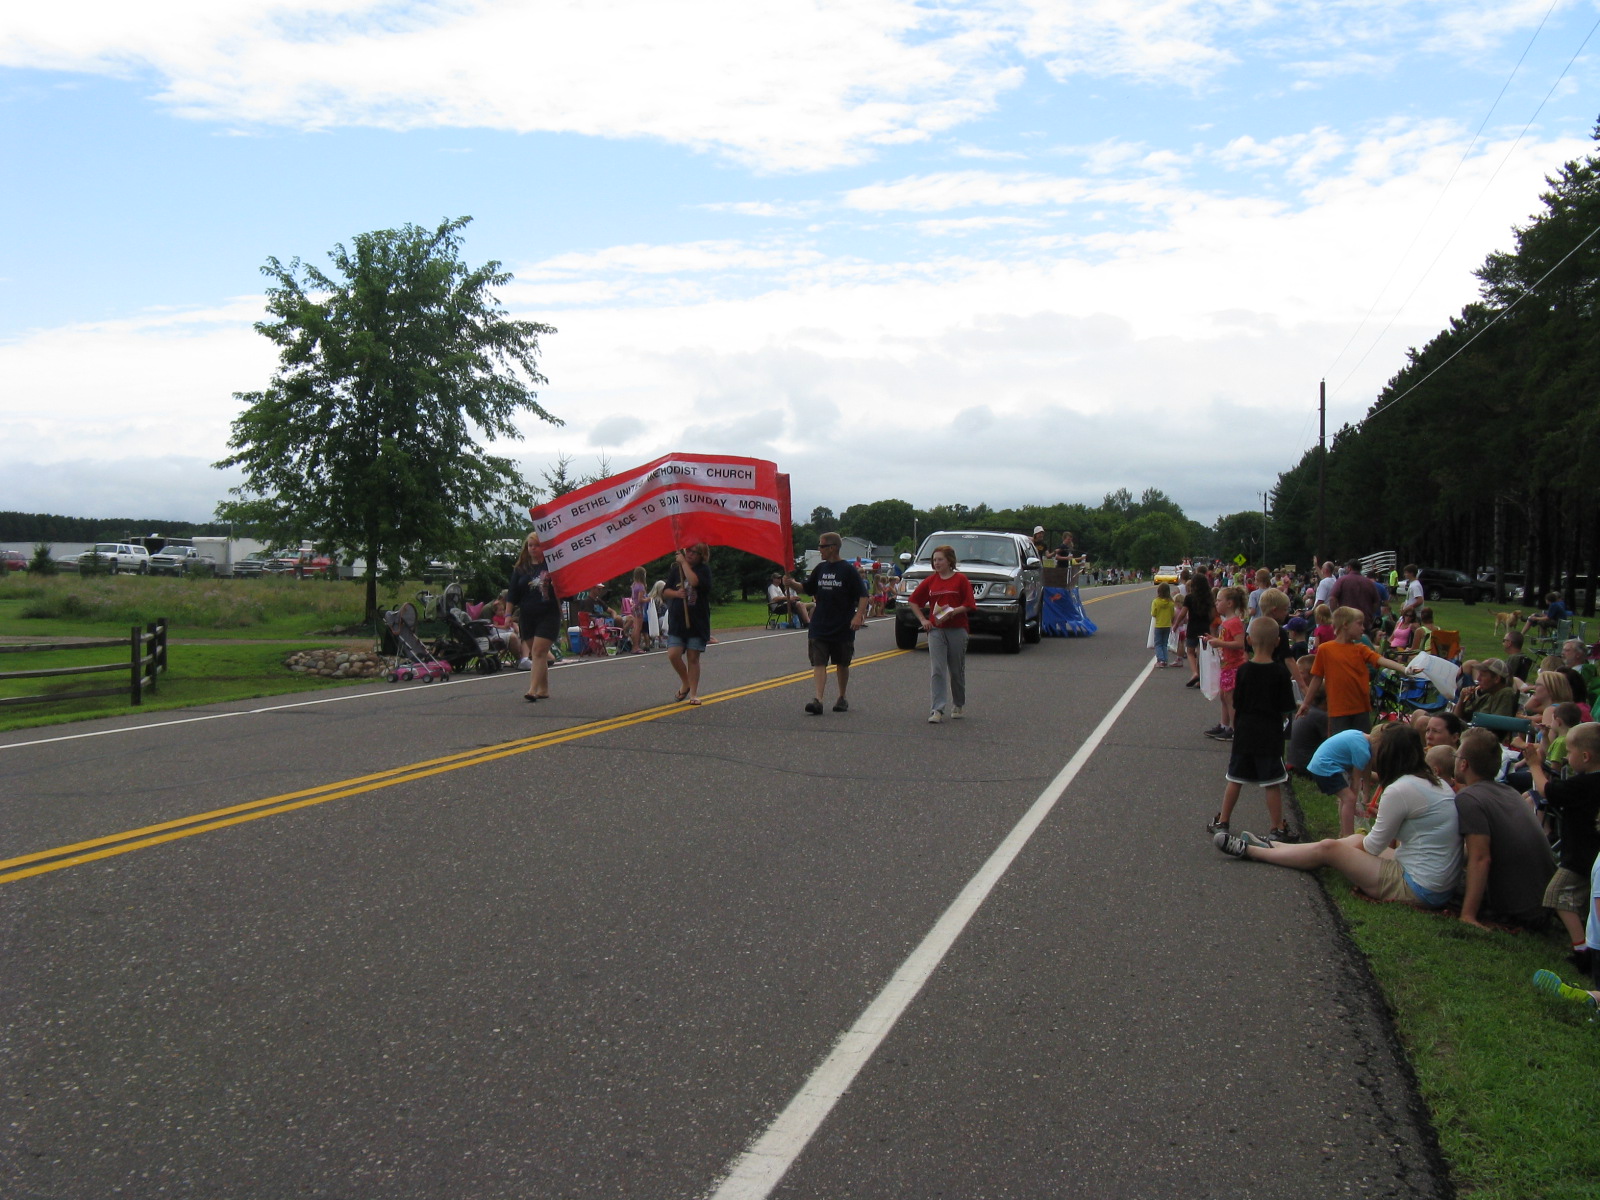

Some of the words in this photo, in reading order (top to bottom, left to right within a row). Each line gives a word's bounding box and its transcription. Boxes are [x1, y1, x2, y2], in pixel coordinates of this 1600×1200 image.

[537, 514, 562, 533] WEST
[571, 496, 611, 518] BETHEL
[706, 467, 752, 480] CHURCH
[544, 548, 564, 564] THE
[571, 533, 598, 551] BEST
[606, 513, 638, 534] PLACE
[642, 504, 656, 516] TO
[683, 493, 728, 508] SUNDAY
